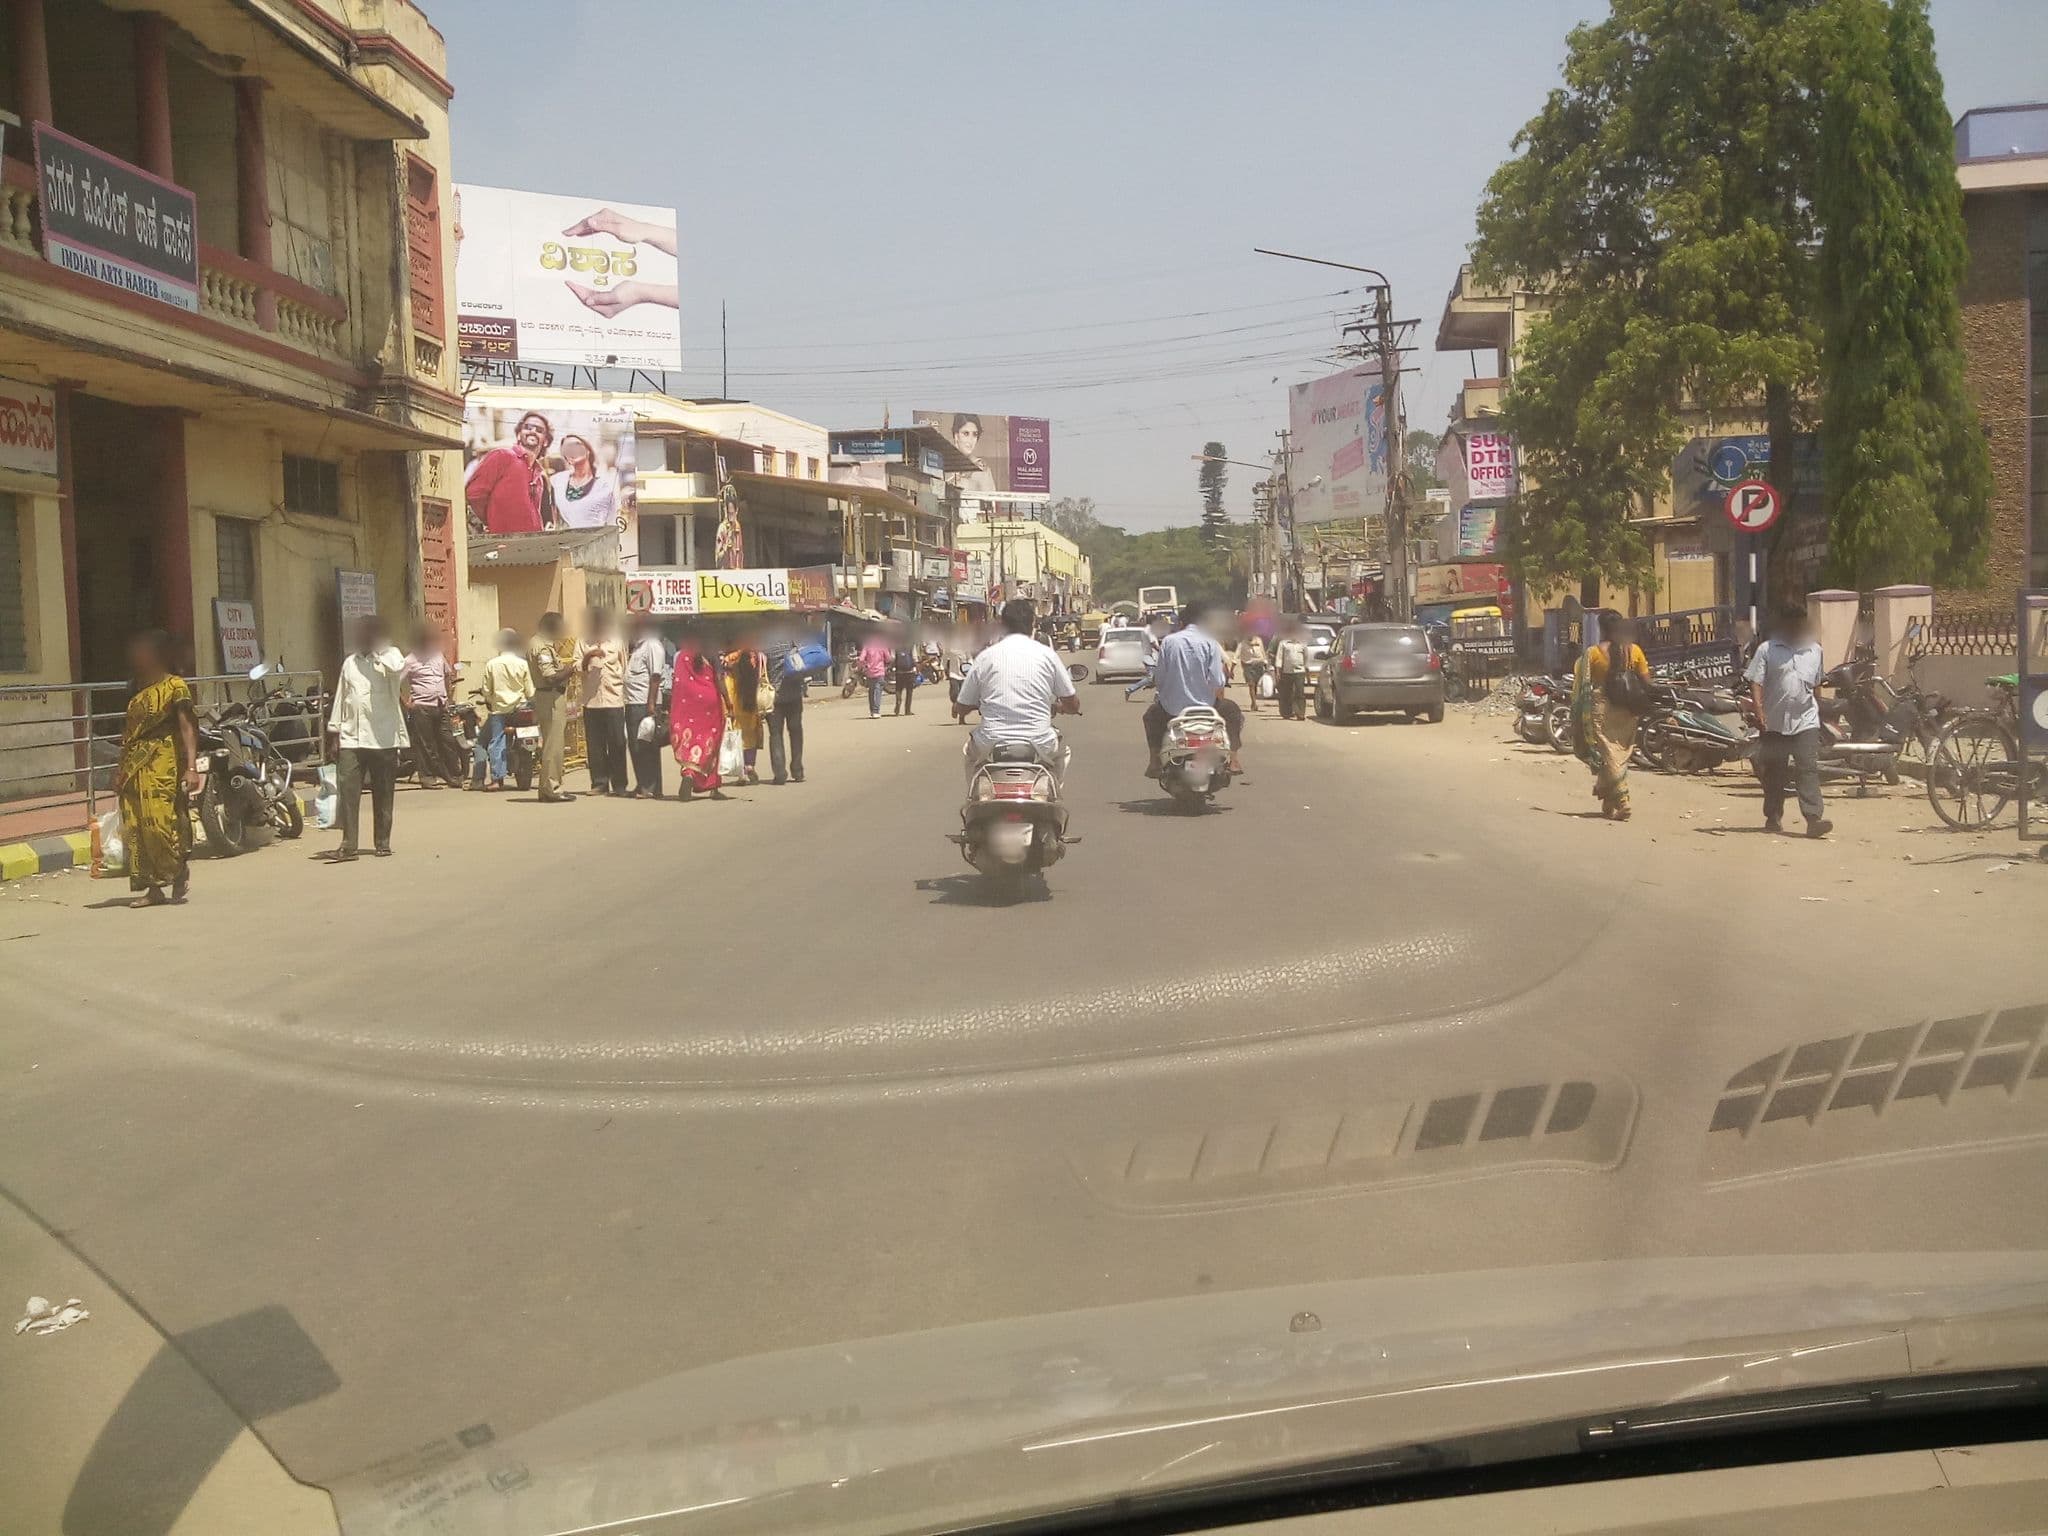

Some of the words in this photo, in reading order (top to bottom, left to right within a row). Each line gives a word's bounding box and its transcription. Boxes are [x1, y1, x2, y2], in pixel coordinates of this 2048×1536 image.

[45, 155, 76, 217] ನಗರ
[162, 210, 192, 264] ಹಾಸನ
[540, 241, 637, 286] ವಿಶ್ವಾಸ
[61, 247, 98, 277] INDIAN
[101, 263, 123, 287] ARTS
[125, 270, 159, 298] HABEEB
[1471, 434, 1510, 448] SUN
[1471, 450, 1510, 464] DTH
[1471, 465, 1512, 480] OFFICE
[657, 579, 663, 595] 1
[666, 580, 691, 595] FREE
[700, 574, 786, 603] Hoysala
[658, 597, 663, 605] 2
[666, 597, 692, 605] PANTS
